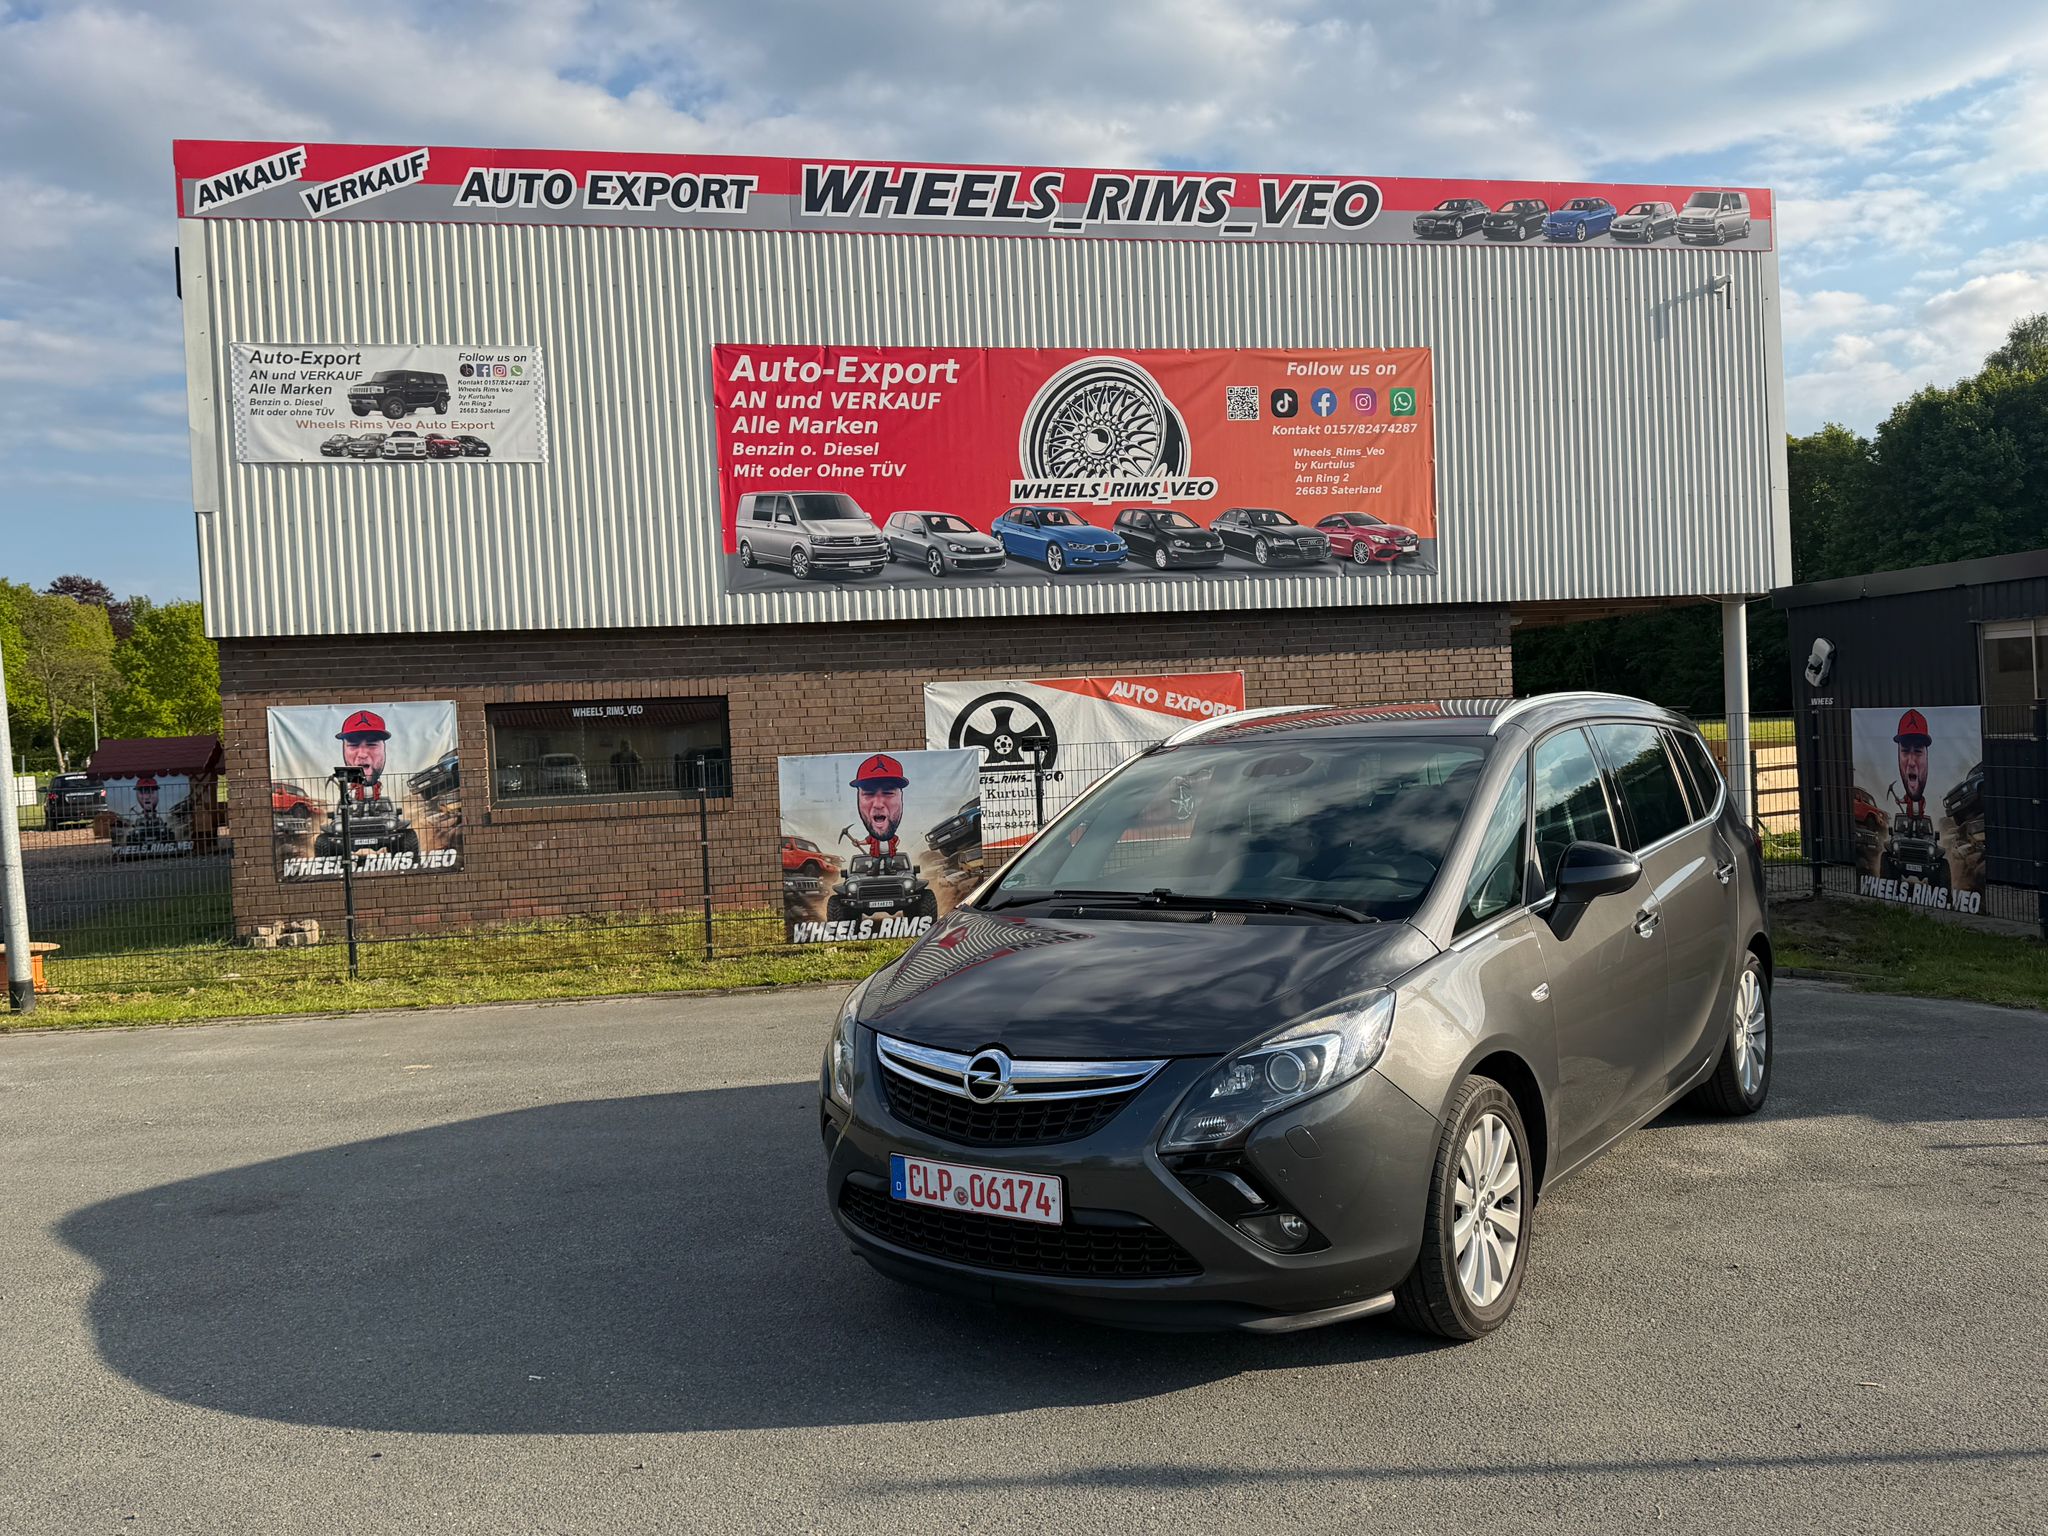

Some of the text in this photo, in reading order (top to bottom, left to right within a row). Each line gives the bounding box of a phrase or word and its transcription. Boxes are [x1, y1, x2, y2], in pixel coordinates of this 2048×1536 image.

[199, 150, 303, 207] ANKAUF
[306, 153, 426, 214] VERKAUF
[459, 171, 756, 210] AUTO EXPORT
[803, 167, 1383, 234] WHEELS_RIMS_VEO
[249, 350, 362, 368] Auto-Export
[458, 353, 494, 362] Follow
[249, 370, 363, 381] AN und VERKAUF
[728, 354, 960, 390] Auto-Export
[1286, 361, 1397, 376] Follow us on
[248, 383, 332, 395] Alle Marken
[249, 398, 284, 406] Benzin
[295, 398, 323, 406] Diesel
[471, 400, 487, 408] Ring
[730, 390, 942, 411] AN und VERKAUF
[250, 407, 335, 416] Mit oder ohne TÜV
[296, 420, 495, 431] Wheels Rims Veo Auto Export
[731, 415, 879, 434] Alle Marken
[1272, 423, 1418, 436] Kontakt 0157/82474287
[732, 442, 880, 456] Benzin o. Diesel
[1293, 447, 1385, 459] Wheels_Rims_Veo
[733, 462, 907, 478] Mit oder Ohne TÜV
[1294, 460, 1355, 471] by Kurtulus
[1295, 473, 1350, 484] Am Ring 2
[1295, 485, 1382, 496] 26683 Saterland
[1107, 680, 1237, 717] AUTO EXPORT
[572, 705, 643, 718] WHEELS_RIMS_VEO
[283, 849, 457, 877] WHEELS.RIMS.VEO
[1860, 875, 1981, 914] WHEELS.RIMS.VEO
[896, 1181, 902, 1191] D
[908, 1163, 1052, 1217] CLP 06174
